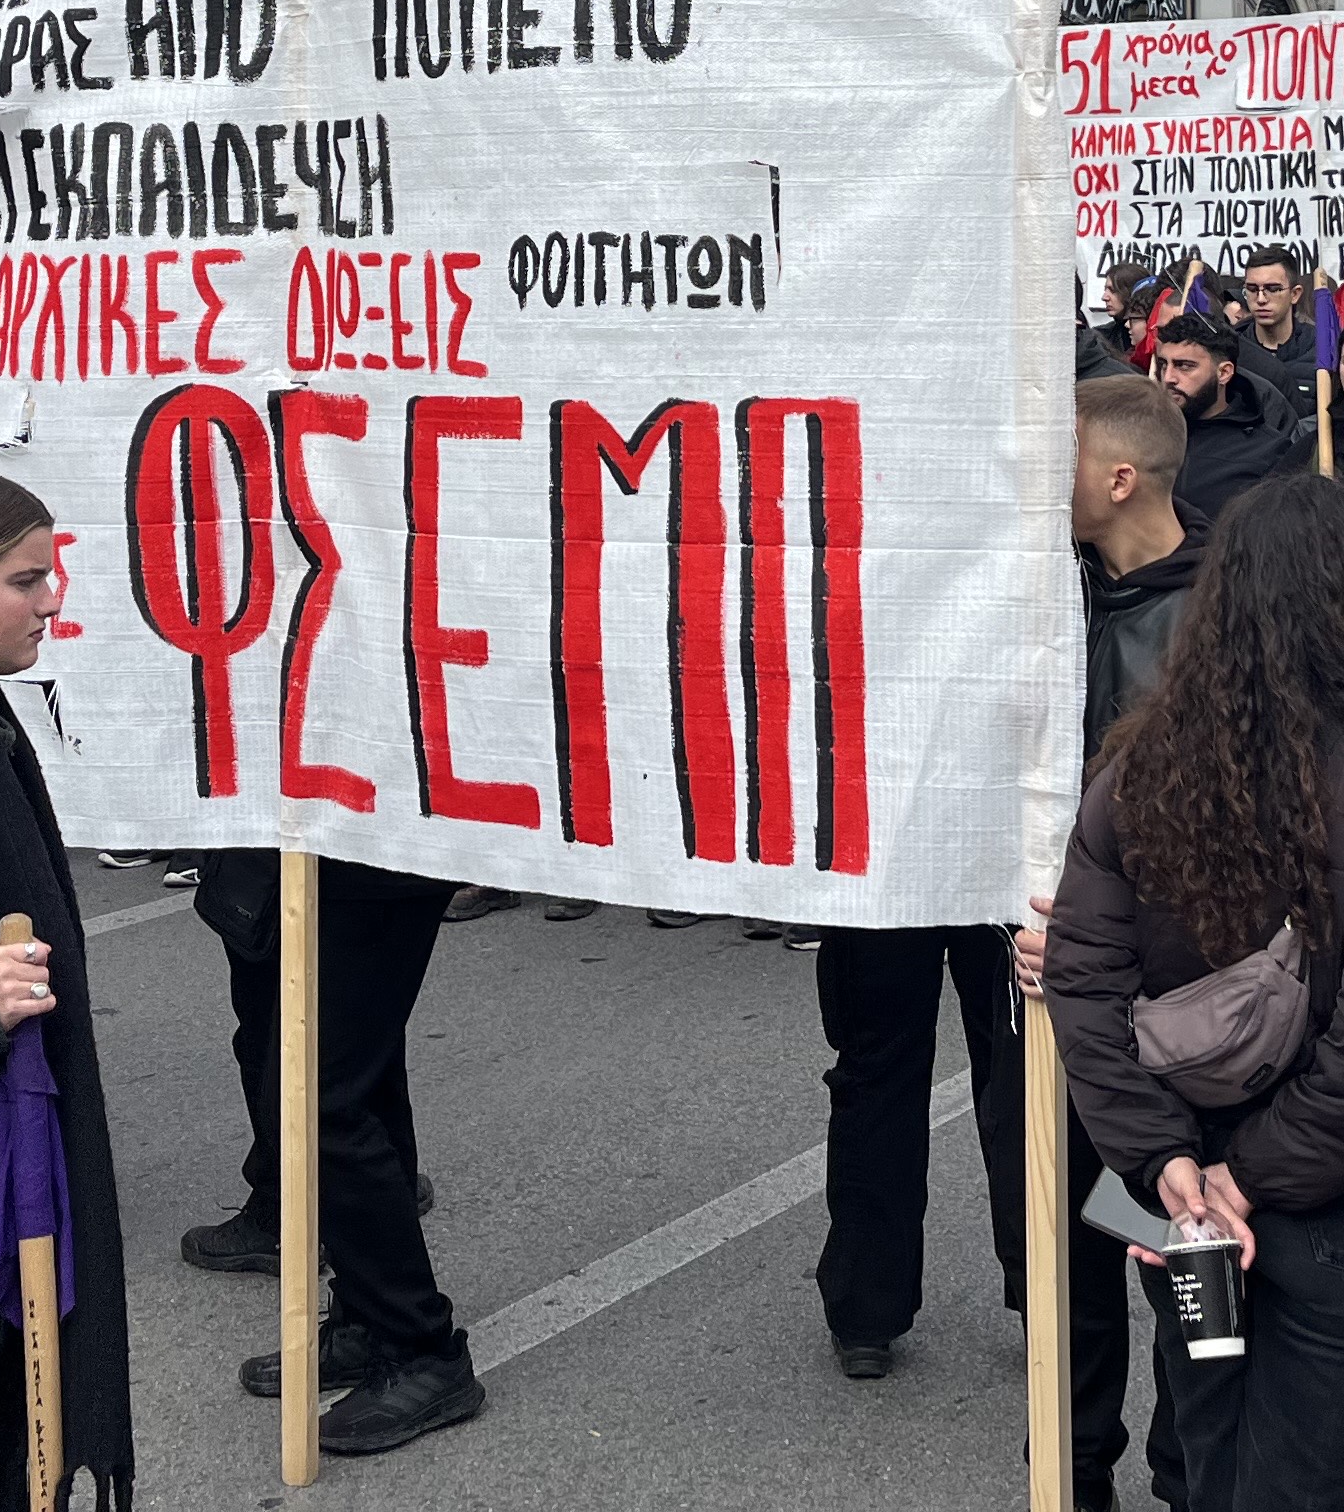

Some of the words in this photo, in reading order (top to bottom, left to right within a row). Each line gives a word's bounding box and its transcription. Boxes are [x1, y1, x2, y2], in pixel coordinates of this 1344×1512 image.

[1060, 29, 1122, 115] 51
[20, 113, 394, 240] ΕΚΠΑΙΔΕΥΣΗ
[1070, 123, 1137, 159] ΚΑΜΙΑ
[1143, 116, 1313, 156] ΣΥΝΕΡΓΑΣΙΑ
[1073, 162, 1120, 197] ΟΧΙ
[1132, 156, 1195, 196] ΣΤΗΝ
[1205, 149, 1317, 194] ΠΟΛΙΤΙΚΗ
[1075, 199, 1120, 238] ΟΧΙ
[1129, 200, 1183, 238] ΣΤΑ
[1194, 197, 1302, 238] ΙΔΙΩΤΙΚΑ
[508, 230, 767, 313] ΦΟΙΤΗΤΩΝ
[125, 383, 869, 876] ΦΣΕΜΠ
